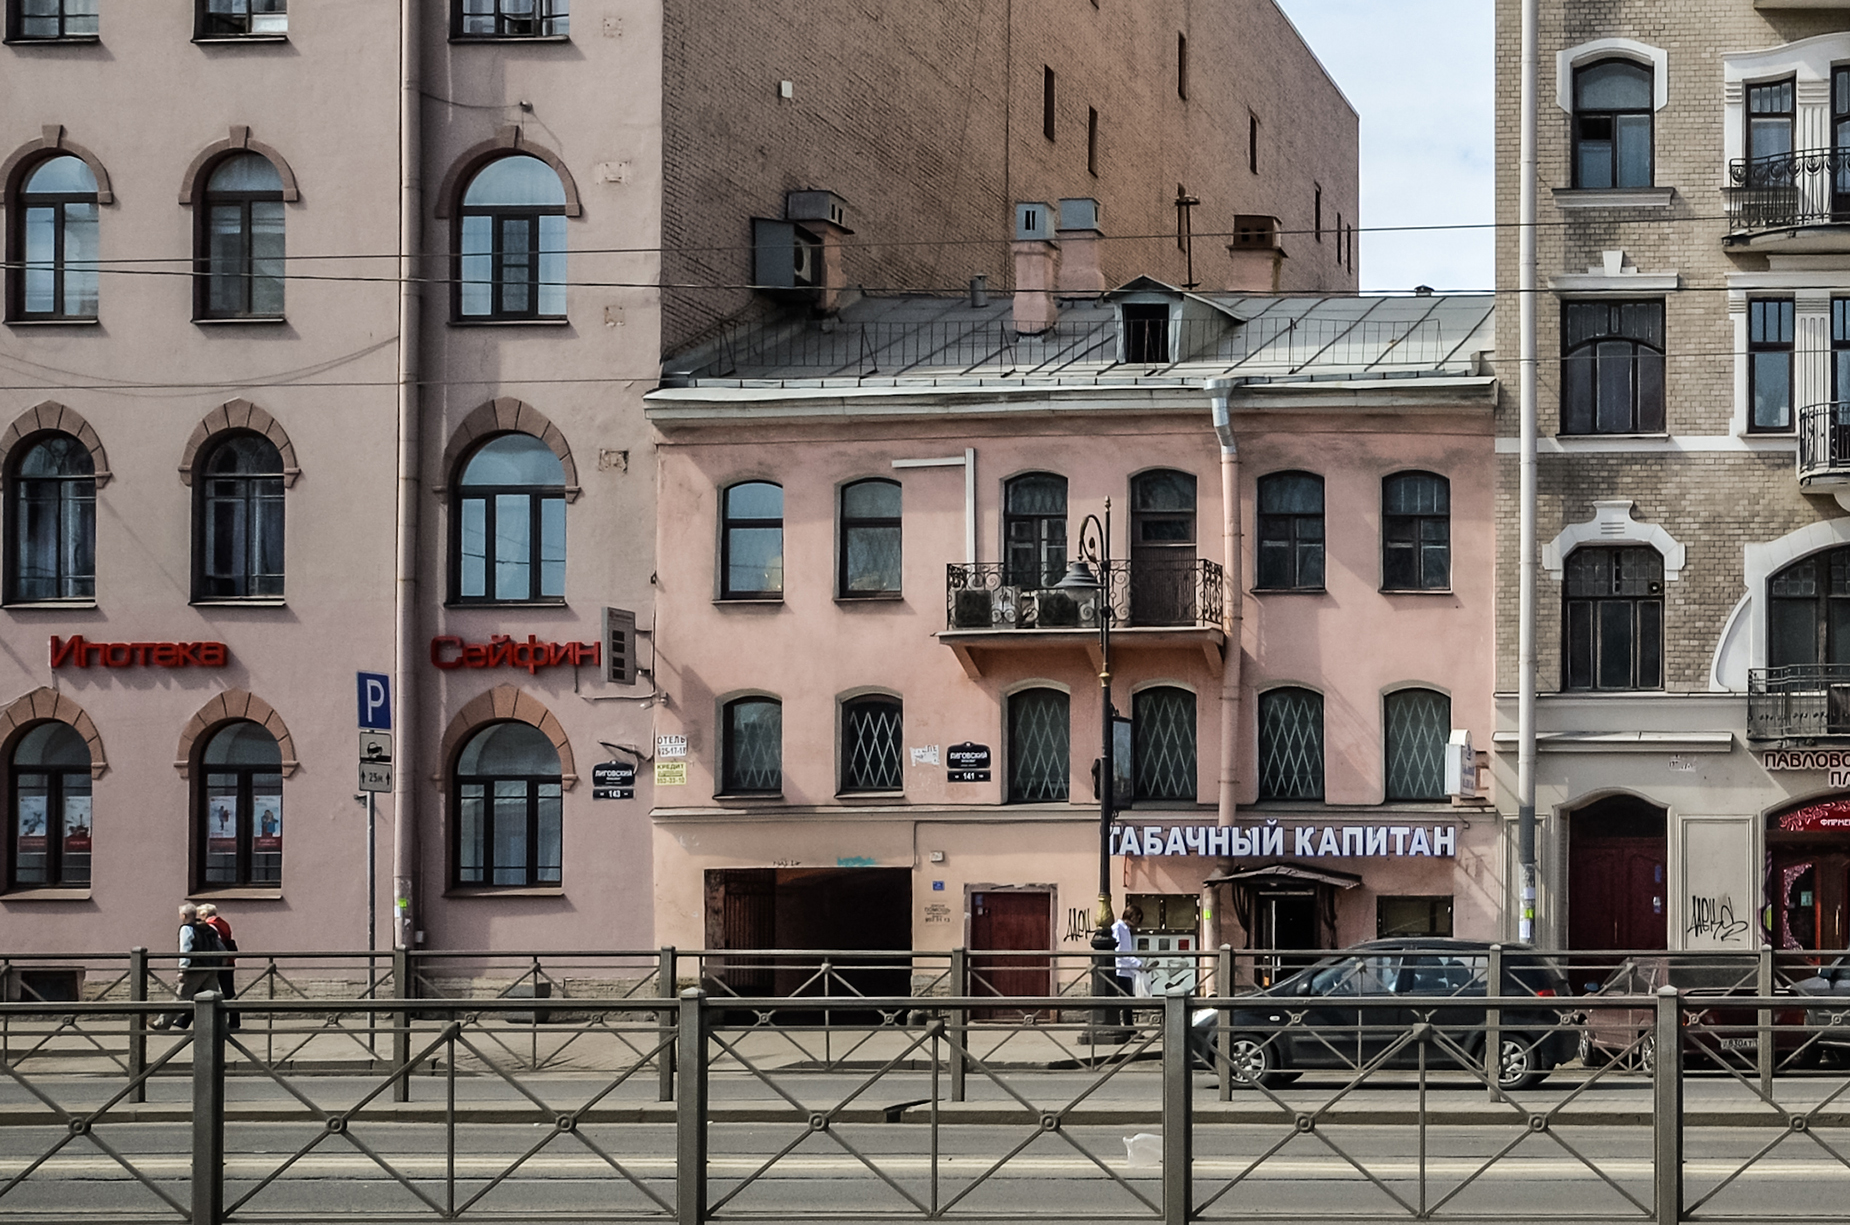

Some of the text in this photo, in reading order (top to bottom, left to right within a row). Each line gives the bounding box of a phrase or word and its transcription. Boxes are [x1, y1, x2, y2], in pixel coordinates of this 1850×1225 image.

[50, 635, 228, 668] Ипотека
[366, 679, 385, 723] P
[657, 736, 686, 744] ОТЕЛЬ
[962, 772, 975, 780] 141
[608, 790, 621, 798] 143
[1109, 819, 1456, 857] ТАБАЧНЫЙ КАПИТАН
